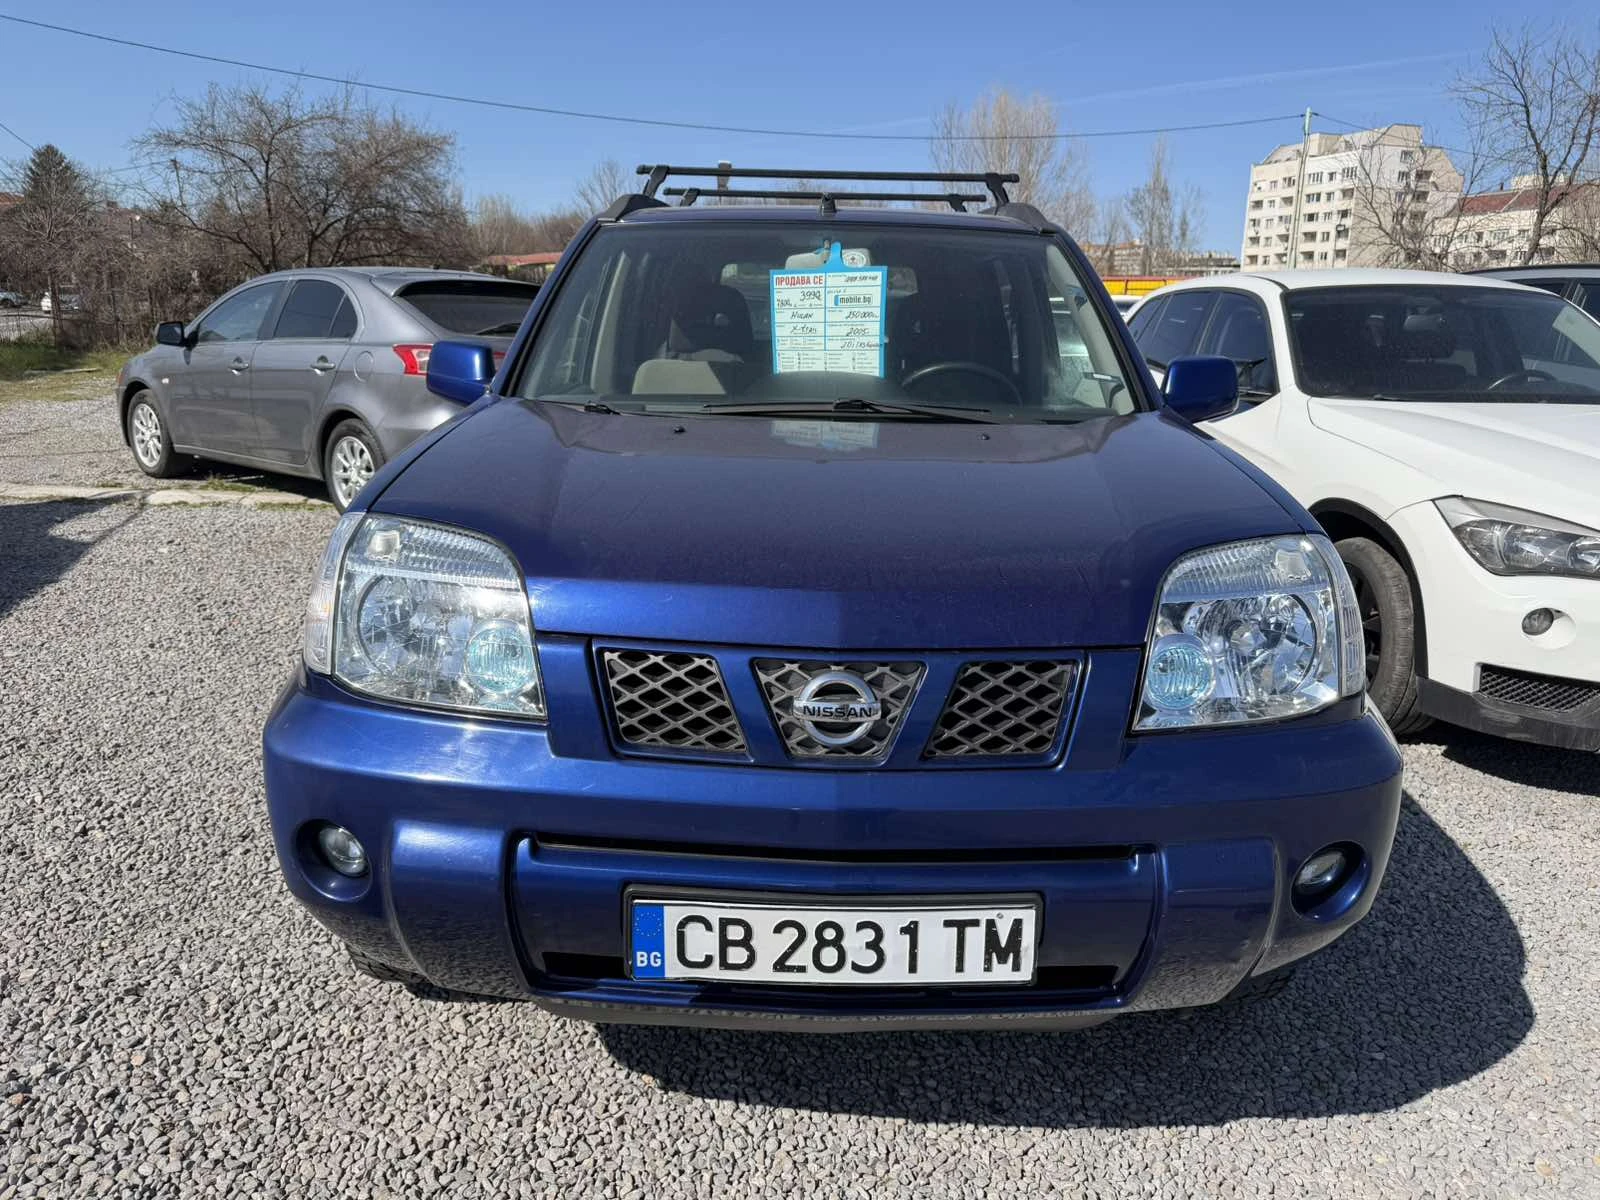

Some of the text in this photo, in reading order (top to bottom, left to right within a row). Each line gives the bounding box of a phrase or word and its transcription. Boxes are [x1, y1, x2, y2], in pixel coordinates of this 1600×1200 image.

[775, 275, 824, 287] ПРОДАВА СЕ
[839, 295, 872, 305] mobile.bg
[803, 705, 872, 718] NISSAN
[675, 914, 1024, 975] CB 2831 TM
[636, 951, 662, 968] BG
